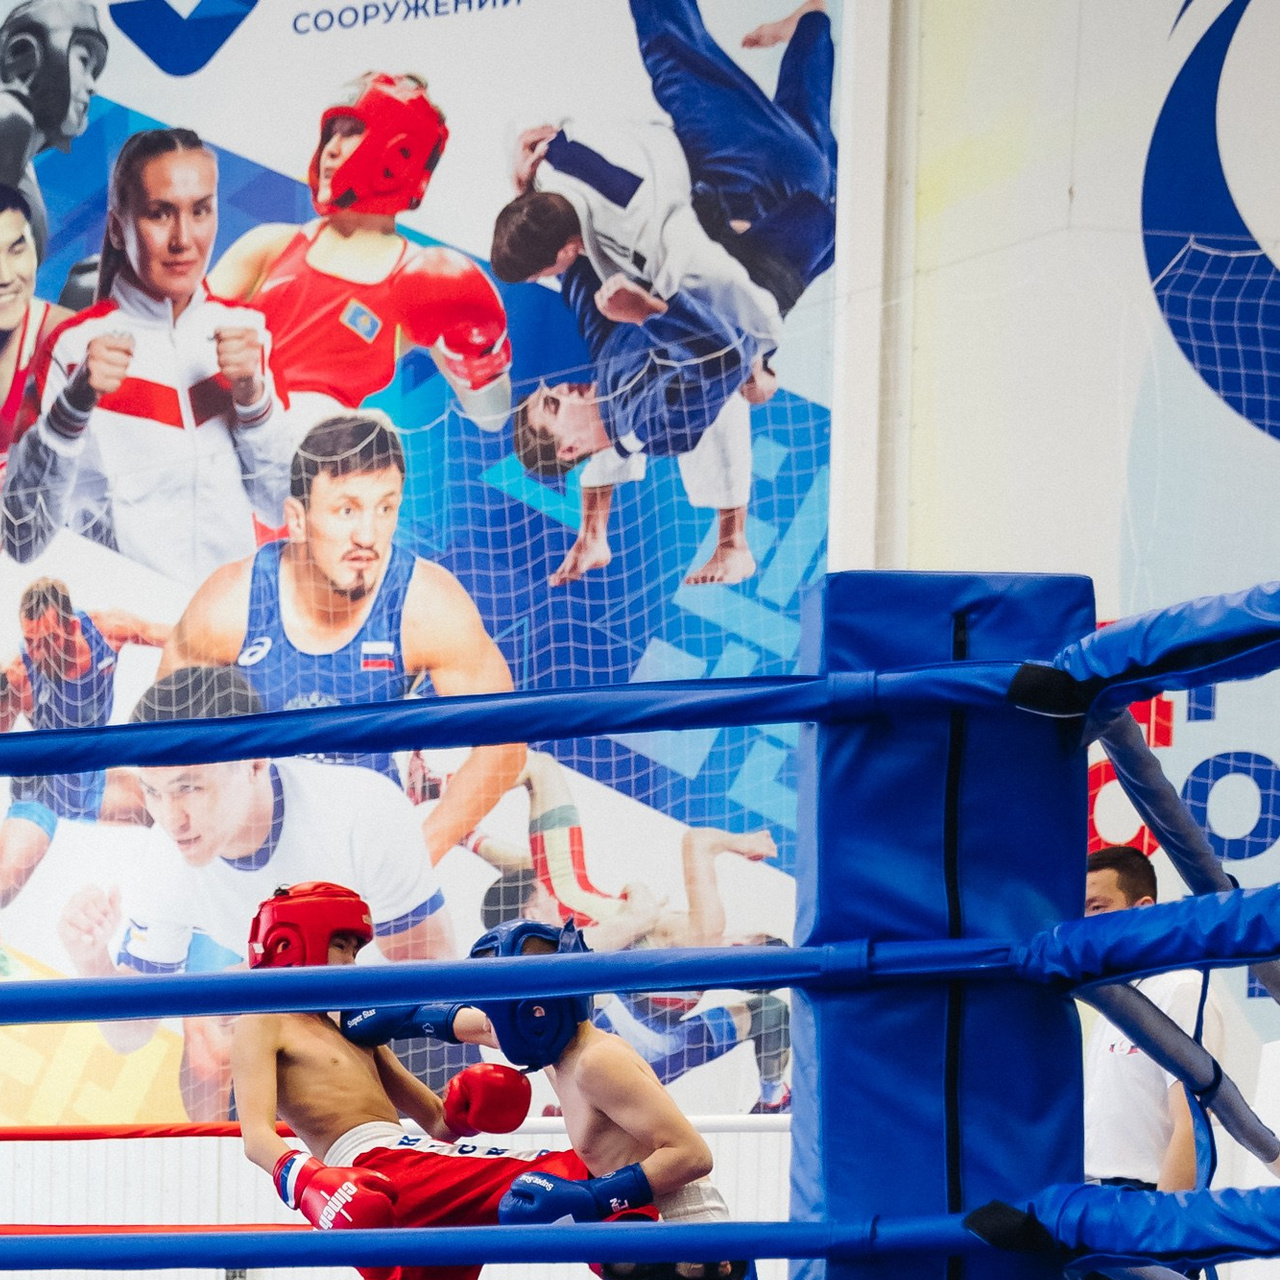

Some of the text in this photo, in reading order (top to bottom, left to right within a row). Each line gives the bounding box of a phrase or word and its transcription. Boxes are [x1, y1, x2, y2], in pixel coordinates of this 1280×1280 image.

[347, 1009, 376, 1028] Super Star
[319, 1181, 358, 1230] clinch
